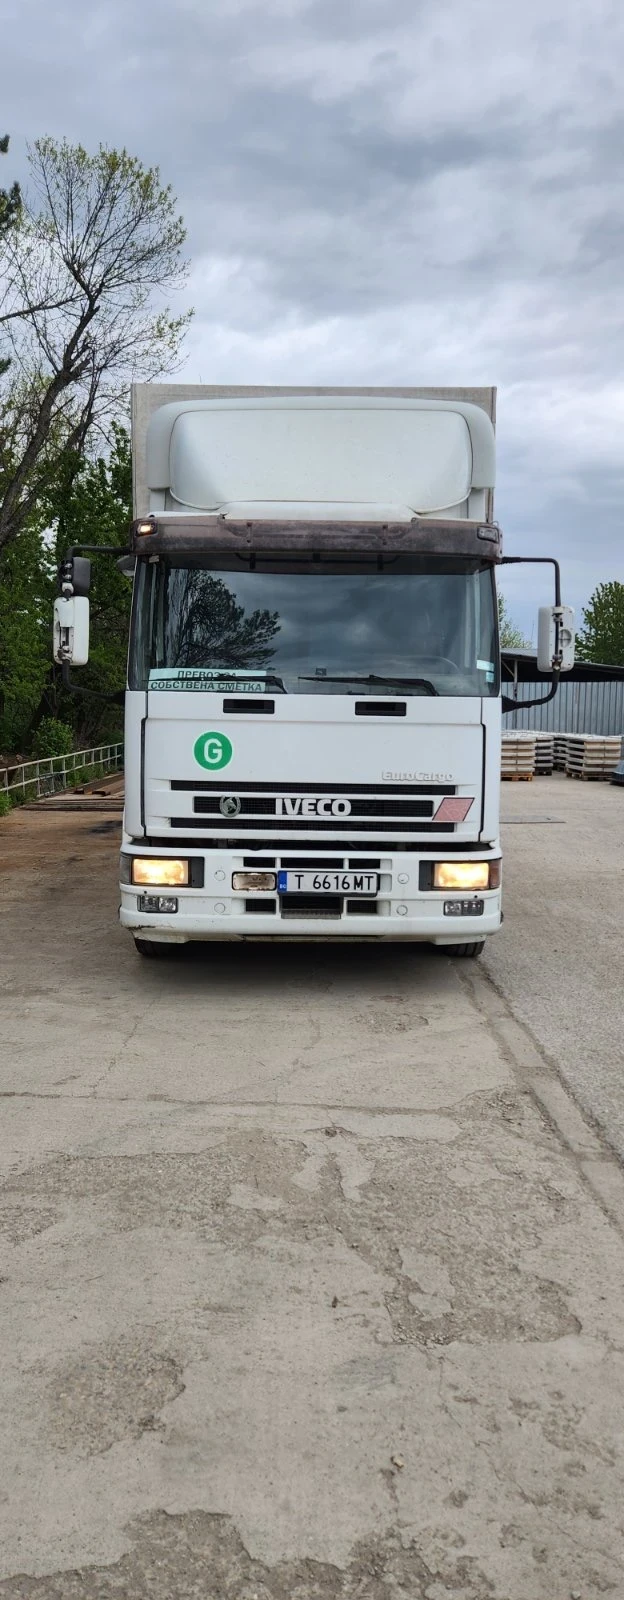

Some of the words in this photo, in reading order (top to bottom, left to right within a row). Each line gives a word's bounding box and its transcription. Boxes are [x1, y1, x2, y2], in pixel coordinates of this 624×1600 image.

[150, 681, 215, 690] СОБСТВЕНА
[217, 682, 262, 691] СМЕТКА
[203, 738, 223, 764] G
[382, 771, 454, 783] EuroCargo
[275, 798, 352, 816] IVECO
